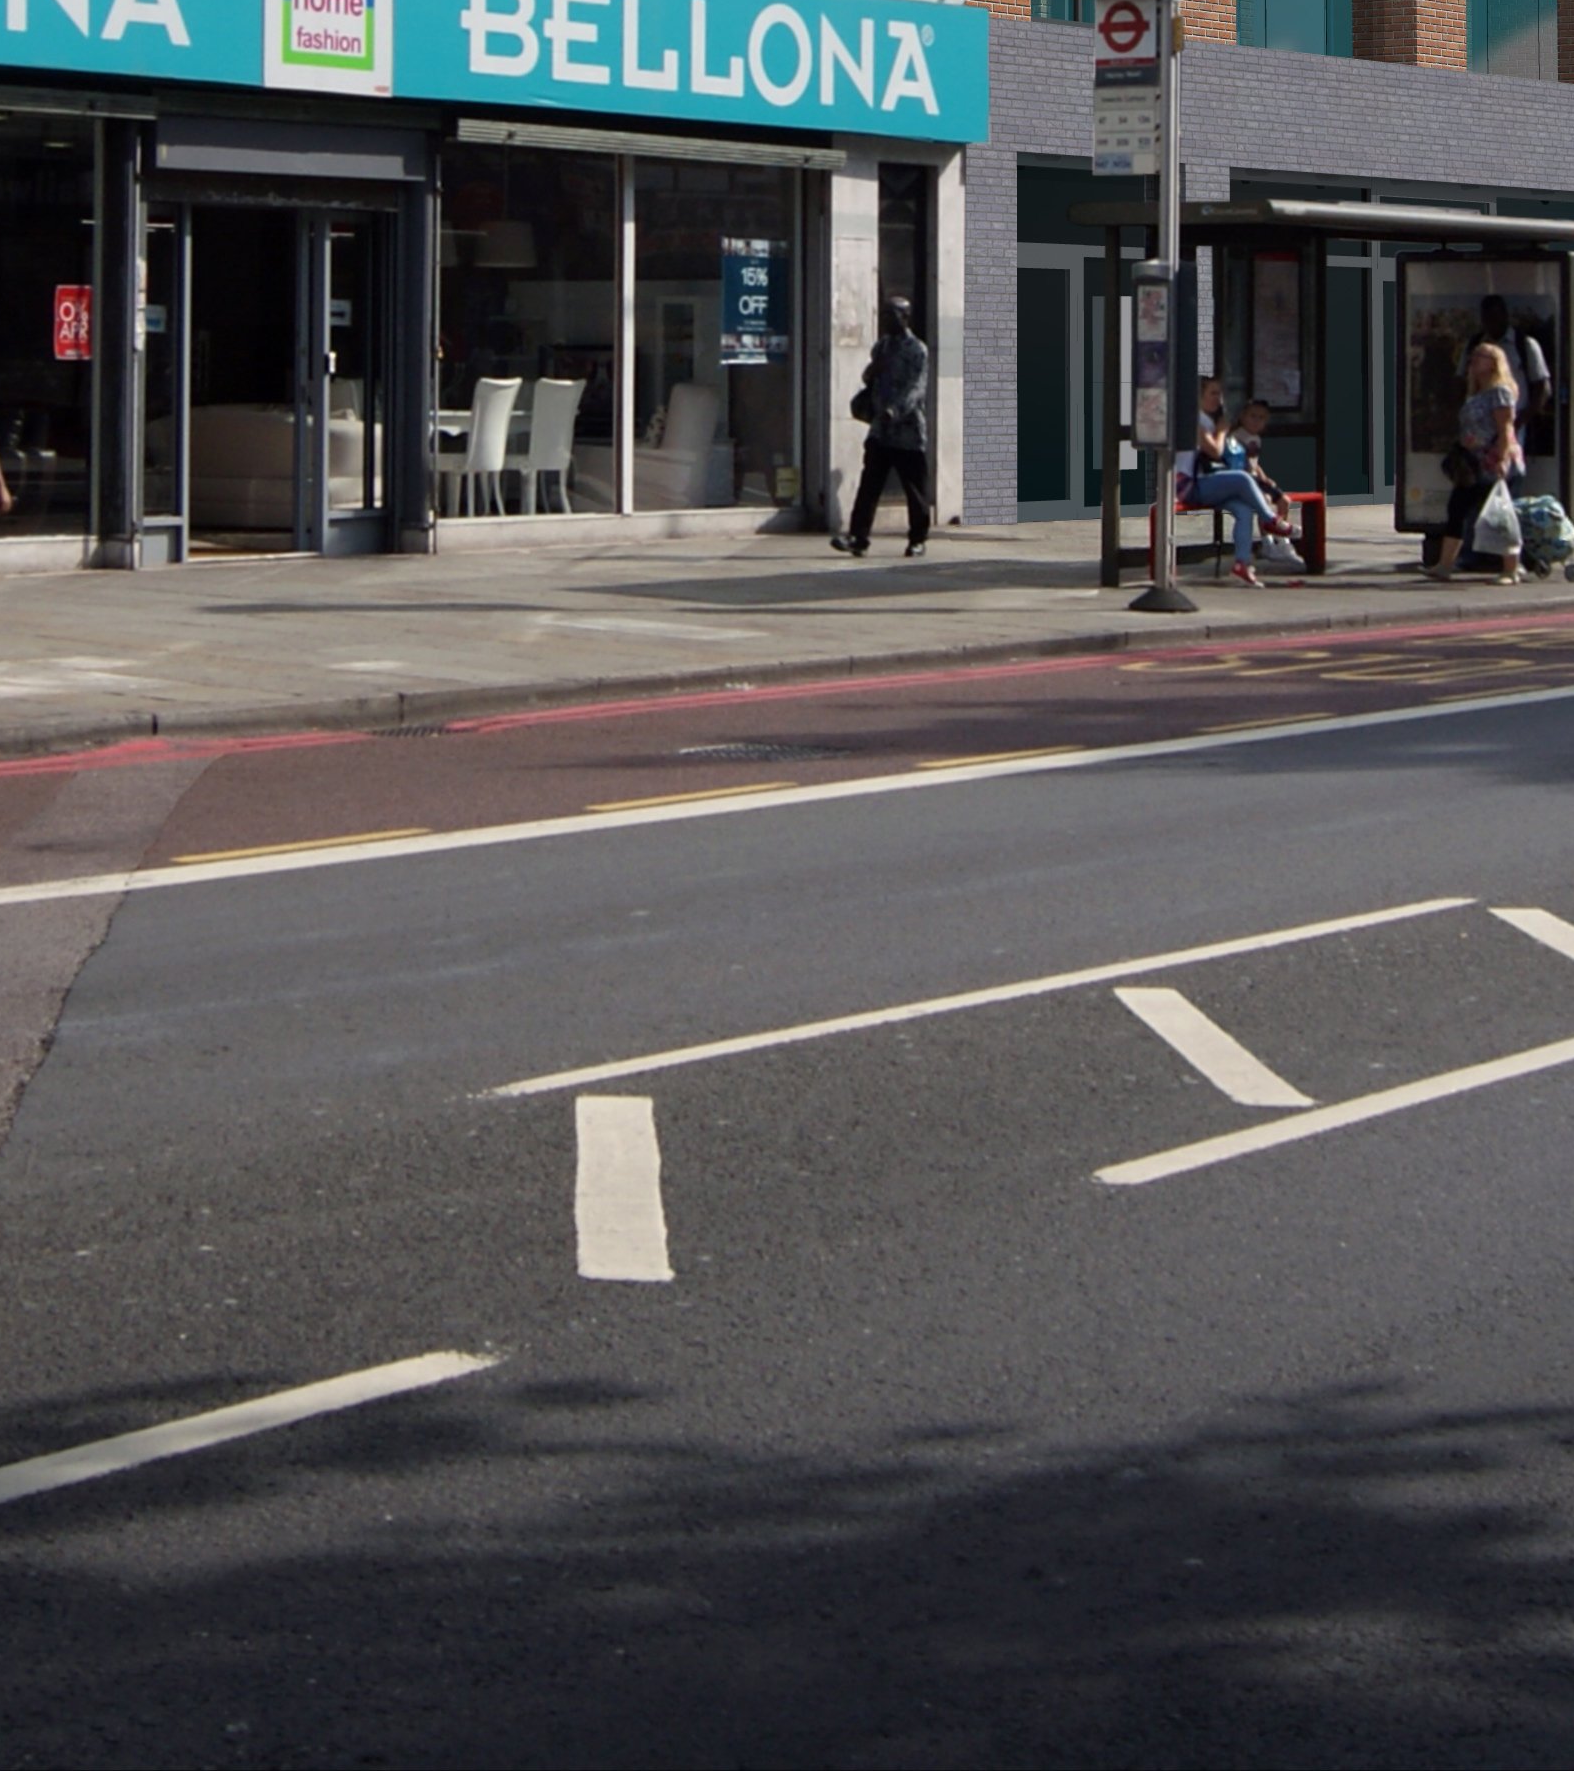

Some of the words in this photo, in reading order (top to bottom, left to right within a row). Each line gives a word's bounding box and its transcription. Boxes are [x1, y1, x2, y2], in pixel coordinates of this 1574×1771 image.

[296, 26, 362, 54] fashion
[740, 267, 769, 287] 15%
[738, 295, 769, 315] OFF
